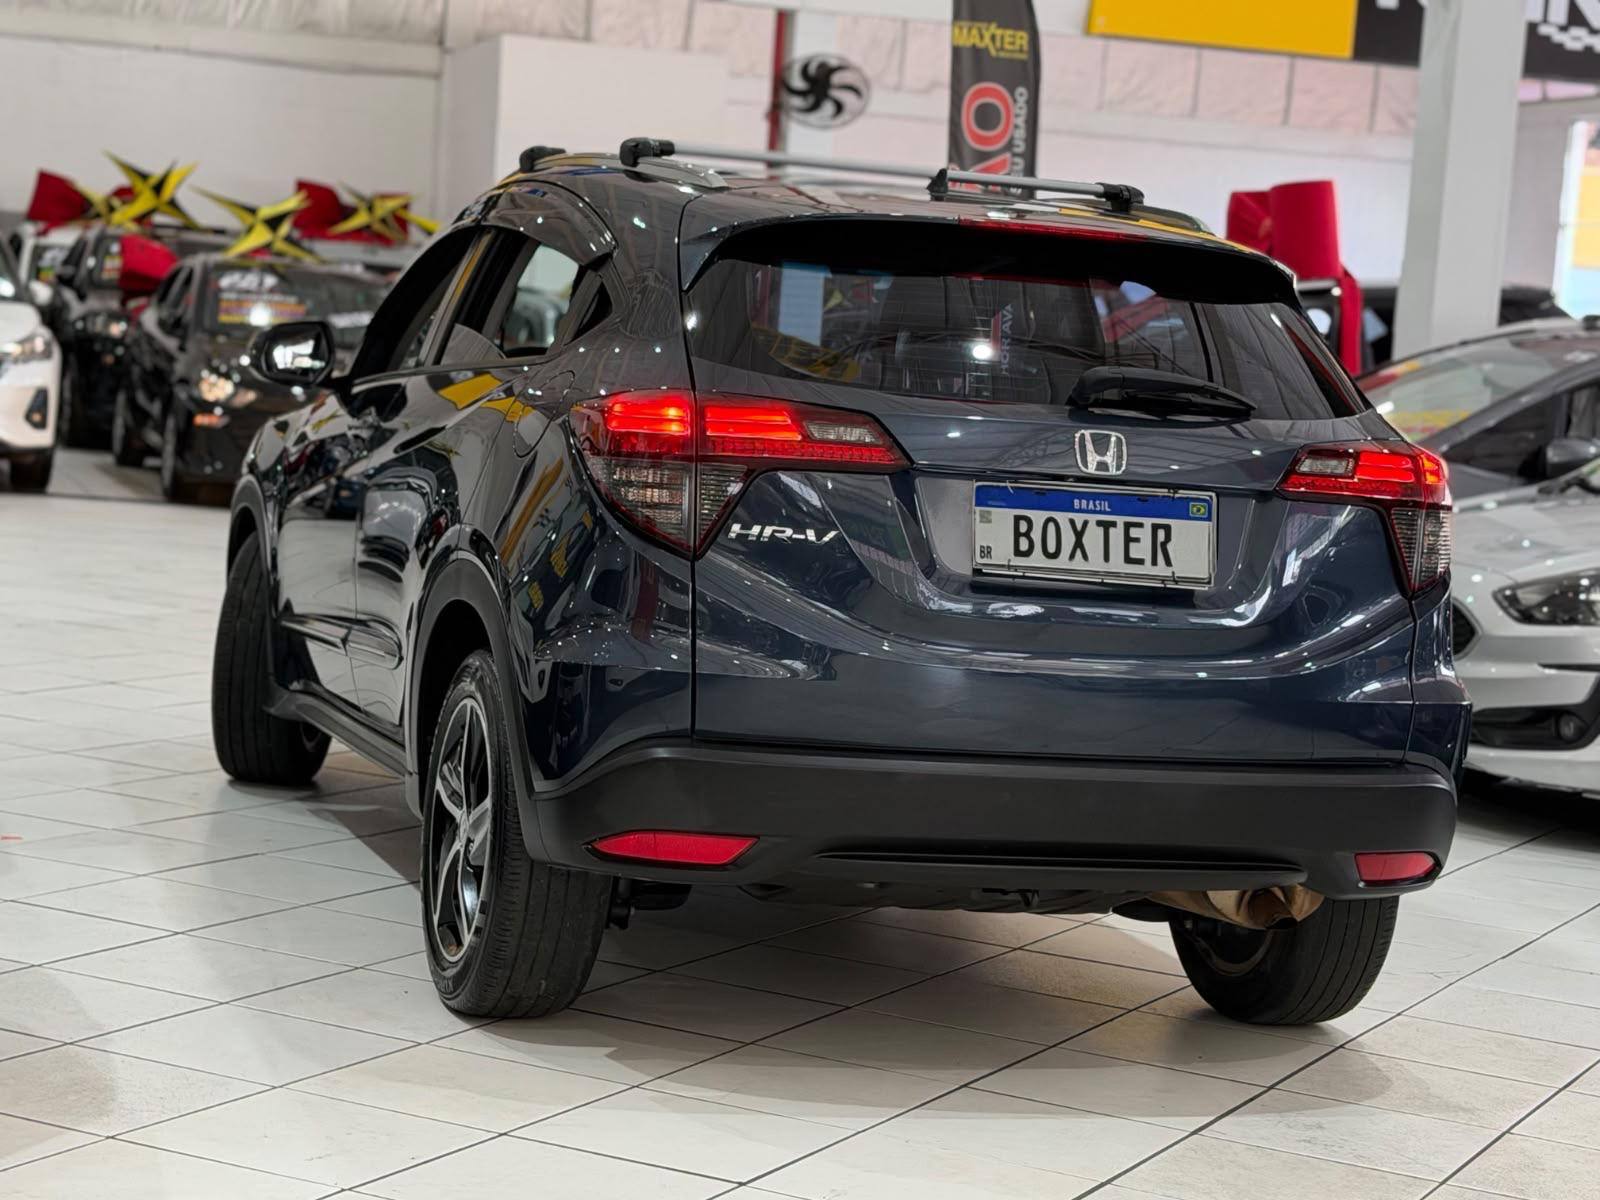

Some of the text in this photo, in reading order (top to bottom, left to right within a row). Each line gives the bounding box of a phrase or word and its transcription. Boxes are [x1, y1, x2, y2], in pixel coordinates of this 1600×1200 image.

[952, 21, 1029, 57] MAXTER
[1012, 86, 1029, 154] USADO
[1073, 498, 1111, 512] BRASIL
[727, 523, 840, 544] HR-V
[1013, 514, 1173, 567] BOXTER
[979, 545, 993, 560] BR
